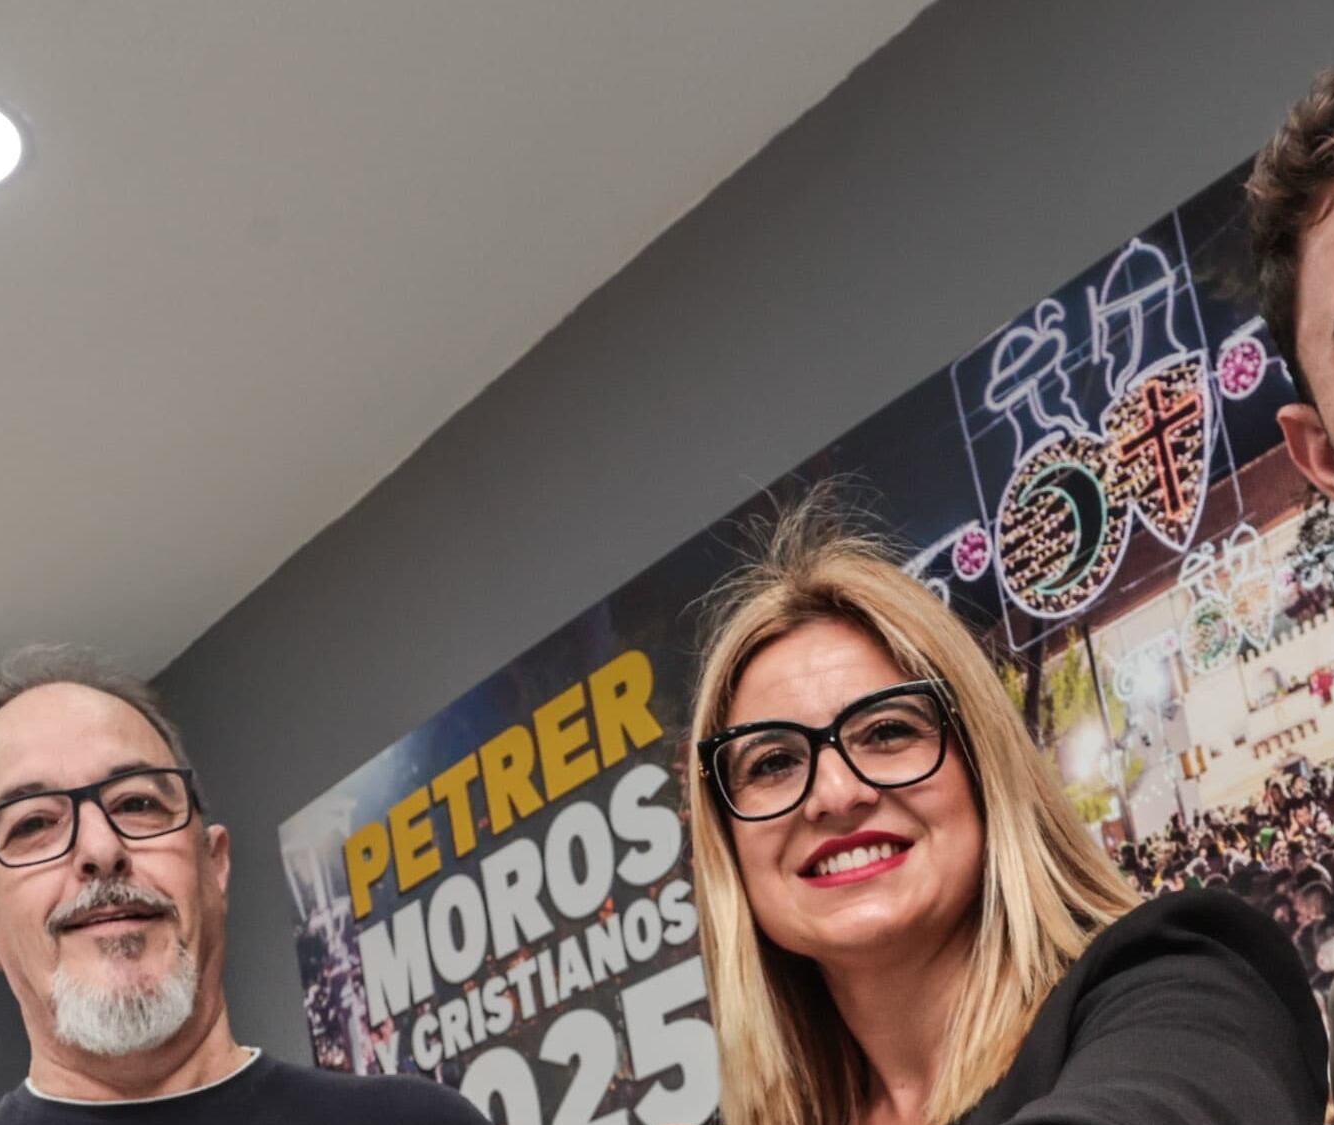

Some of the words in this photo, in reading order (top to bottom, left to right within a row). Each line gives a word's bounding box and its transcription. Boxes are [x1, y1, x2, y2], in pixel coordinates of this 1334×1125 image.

[343, 649, 663, 919] PETRER
[358, 764, 681, 1027] MOROS
[371, 1031, 400, 1075] Y
[411, 881, 699, 1071] CRISTIANOS
